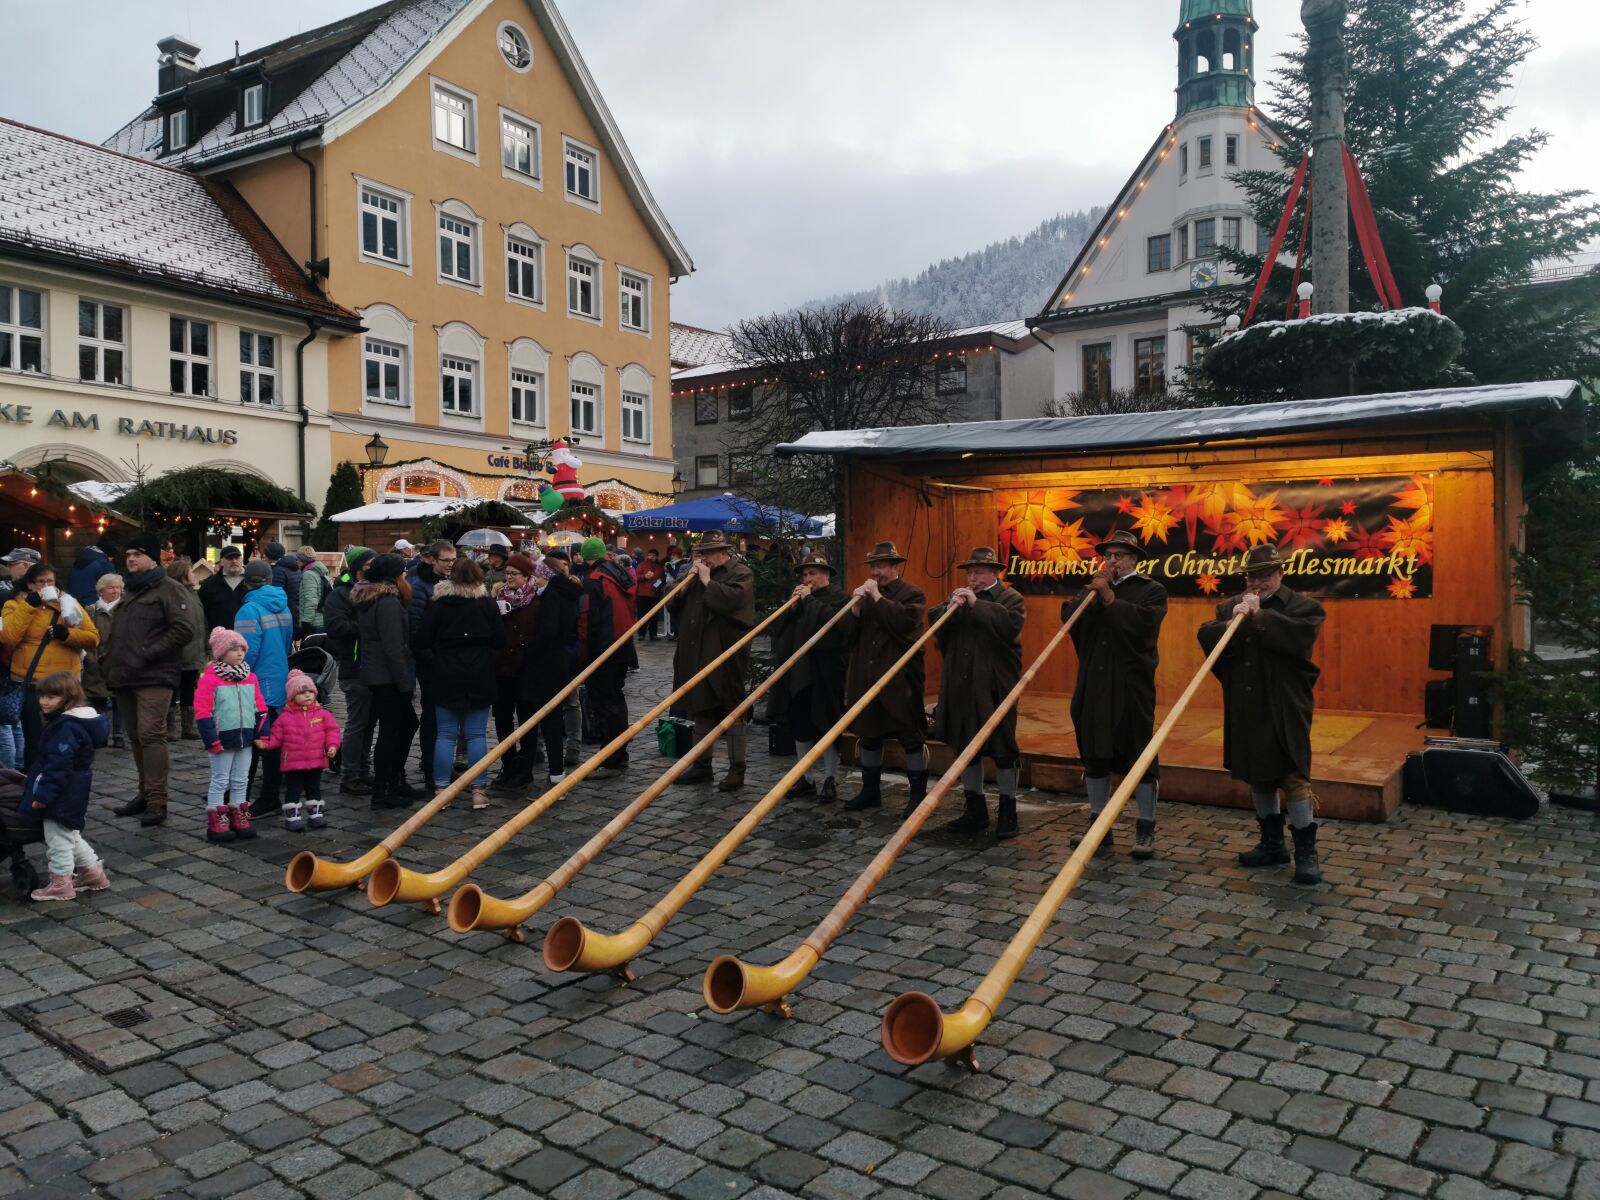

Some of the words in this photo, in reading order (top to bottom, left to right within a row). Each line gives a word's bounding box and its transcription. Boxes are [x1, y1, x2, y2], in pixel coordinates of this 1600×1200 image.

[47, 409, 100, 431] AM
[118, 417, 239, 446] RATHAUS
[488, 454, 509, 469] Café
[628, 515, 663, 528] Zötler
[664, 517, 689, 529] Bier
[1007, 554, 1160, 576] Immenster
[1163, 549, 1418, 581] Christdlesmarkt
